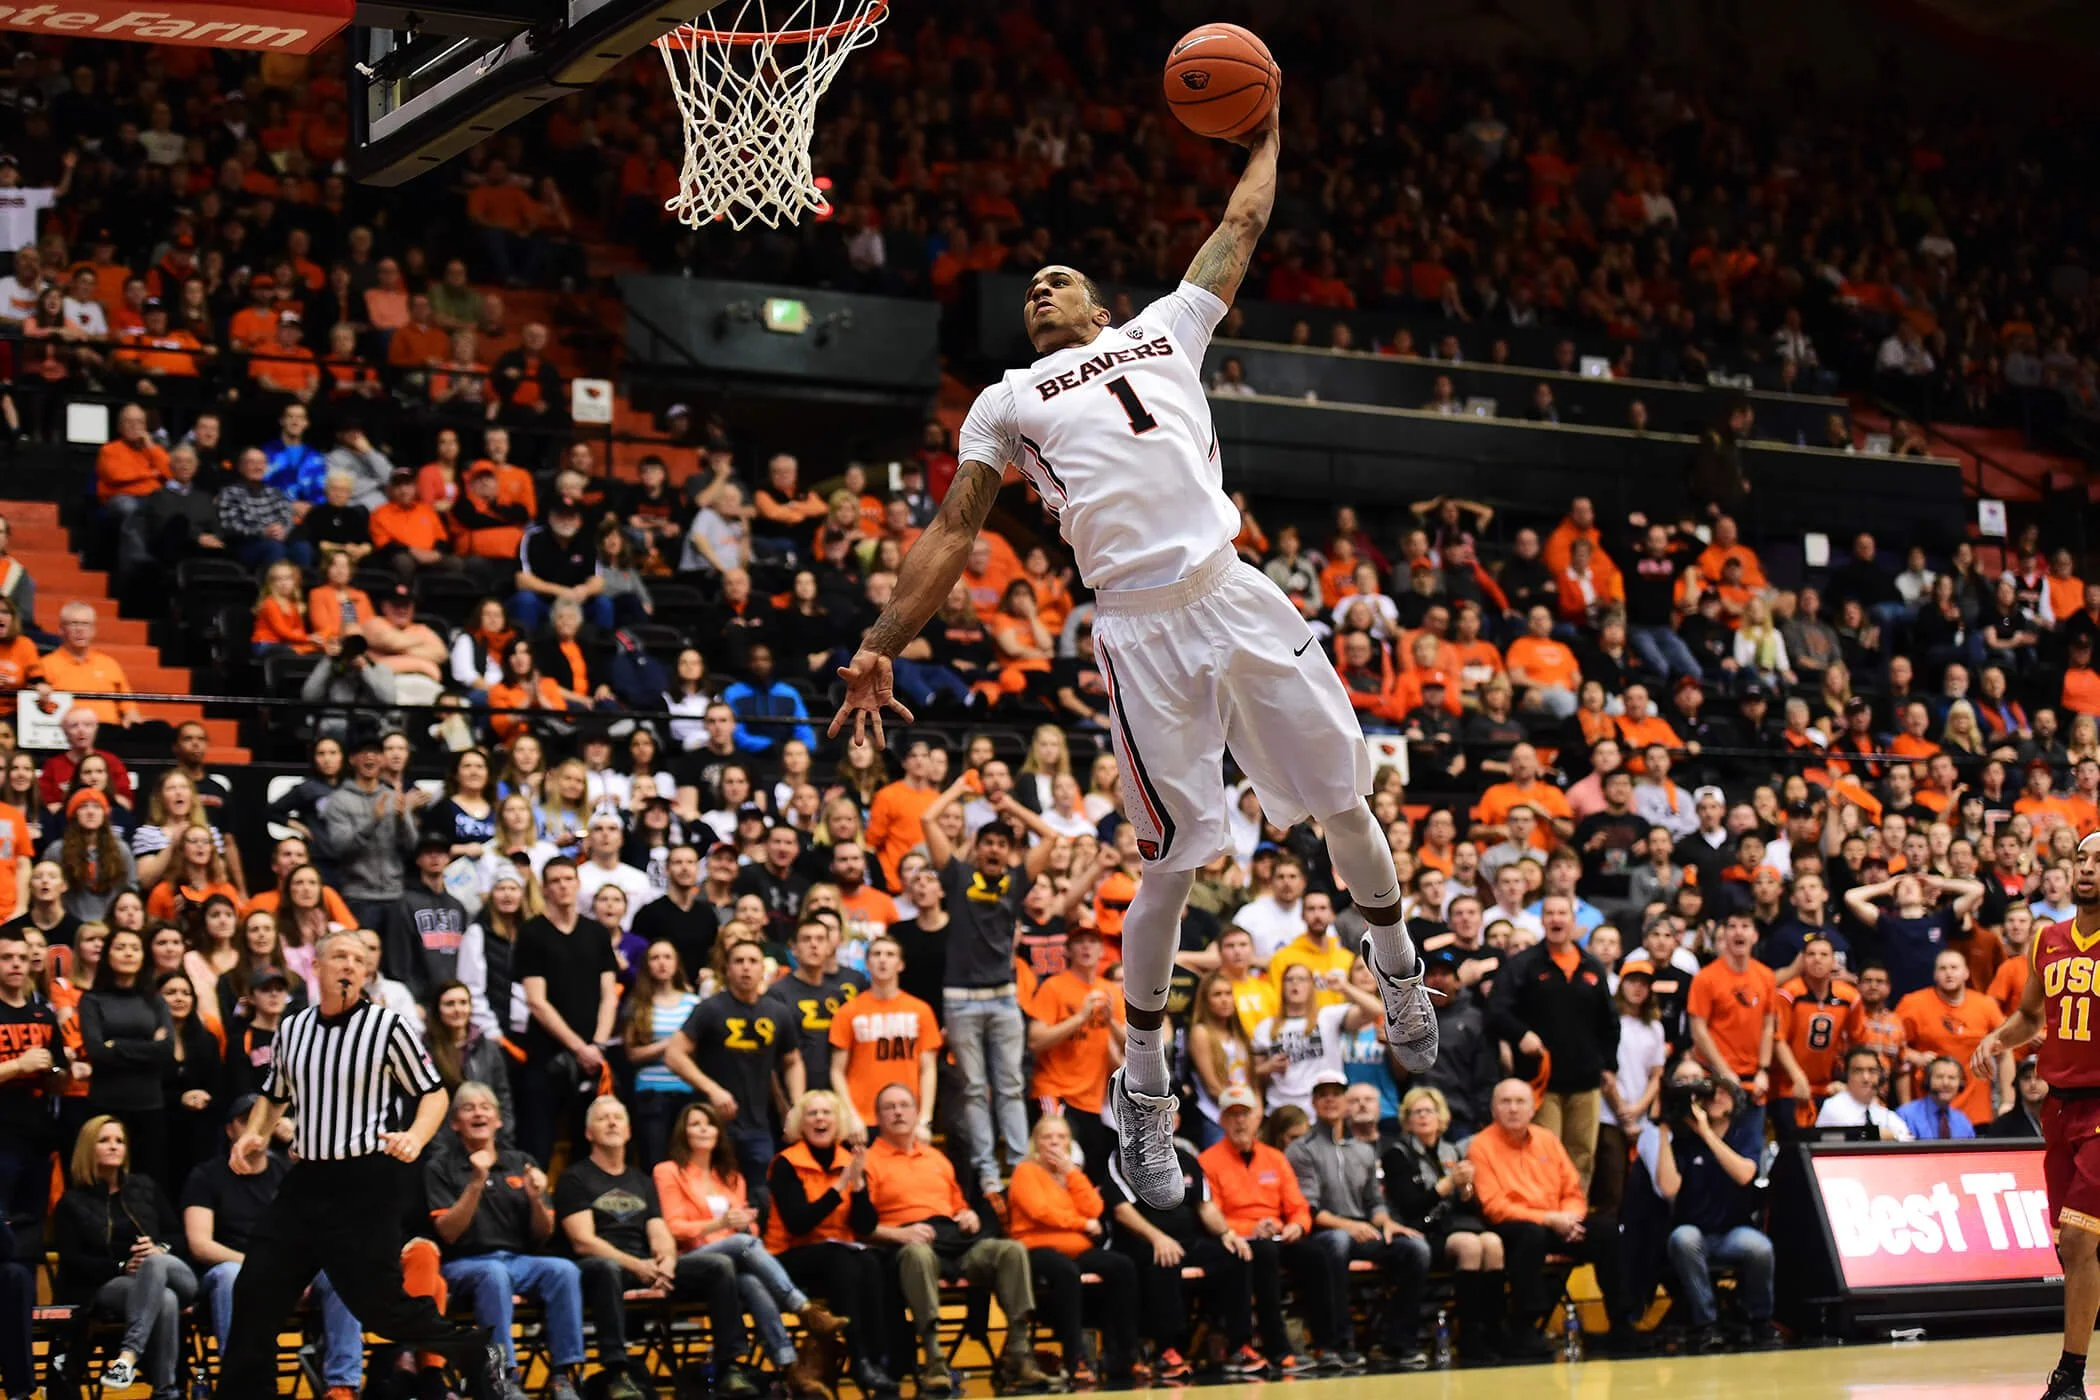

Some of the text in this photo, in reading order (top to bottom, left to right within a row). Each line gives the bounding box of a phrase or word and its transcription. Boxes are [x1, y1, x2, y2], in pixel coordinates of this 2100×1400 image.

[92, 11, 307, 47] Farm
[1035, 336, 1174, 402] BEAVERS
[1104, 375, 1159, 436] 1
[852, 1012, 920, 1043] GAME
[1808, 1013, 1834, 1051] 8
[2058, 995, 2091, 1041] 11
[876, 1036, 917, 1061] DAY
[1821, 1178, 1968, 1257] Best
